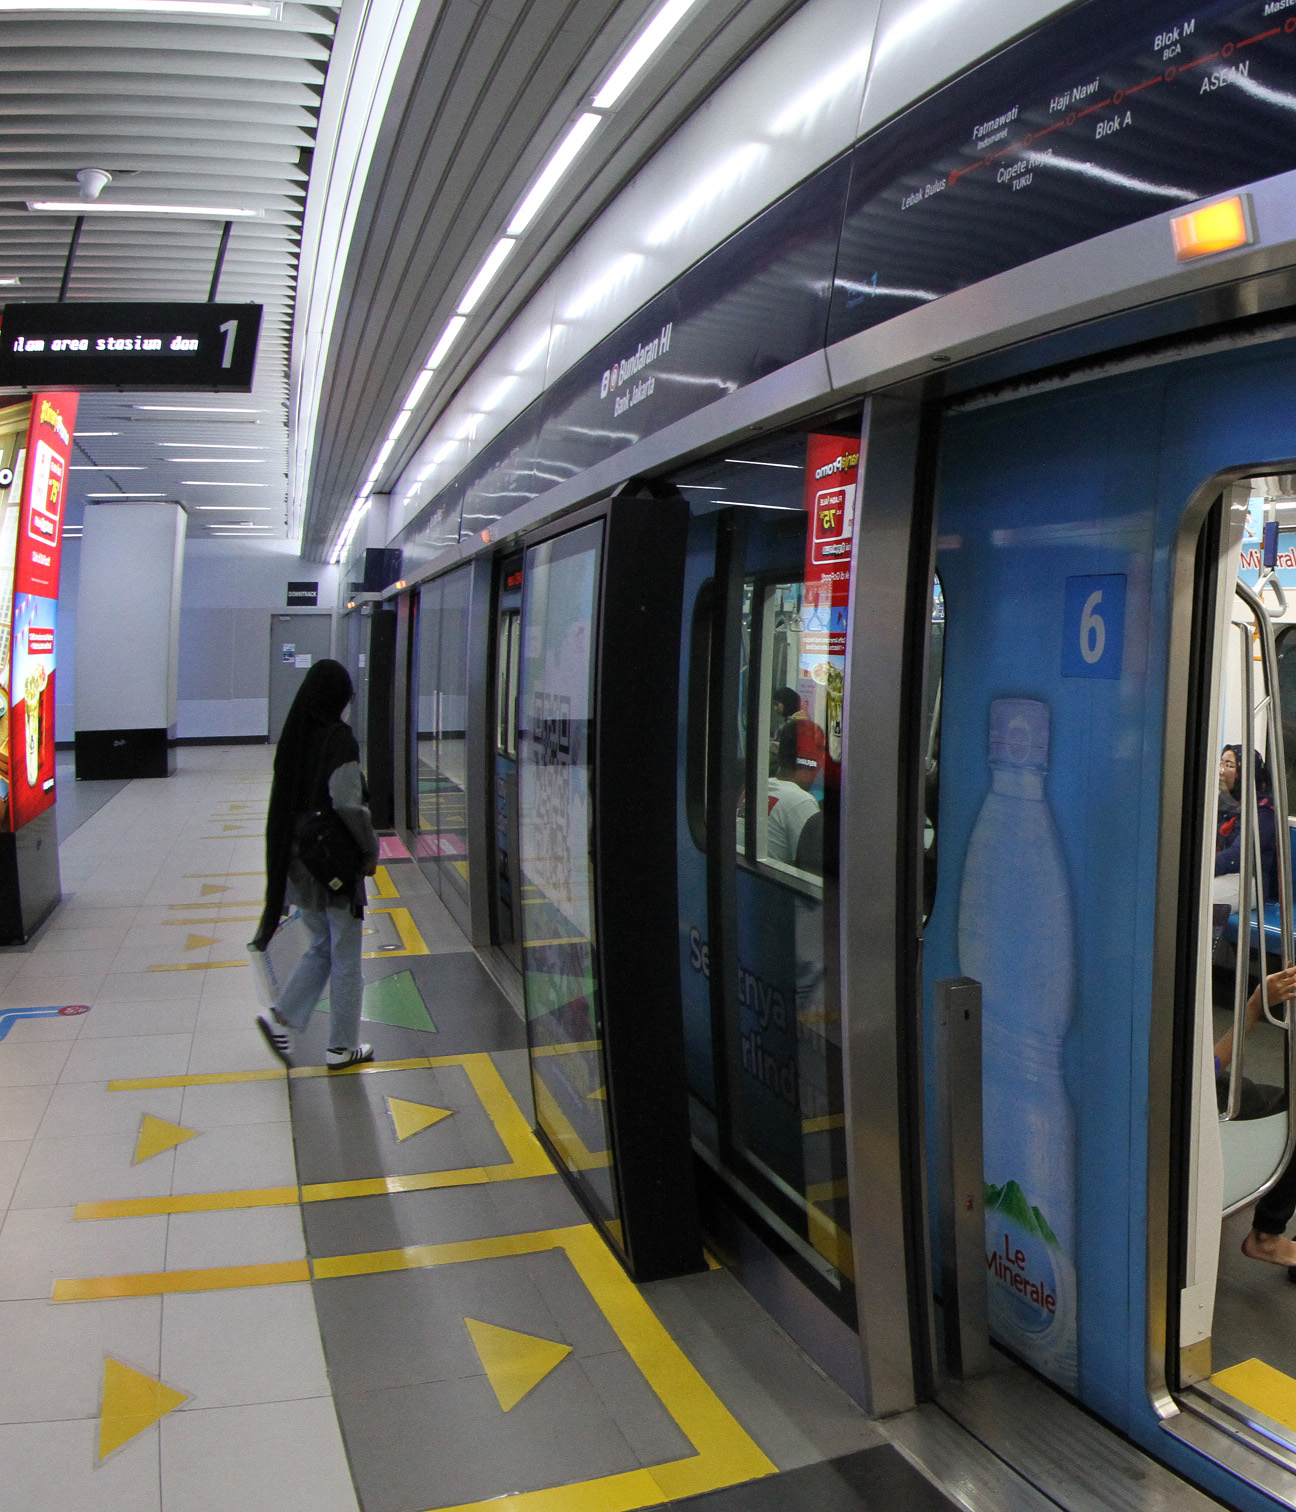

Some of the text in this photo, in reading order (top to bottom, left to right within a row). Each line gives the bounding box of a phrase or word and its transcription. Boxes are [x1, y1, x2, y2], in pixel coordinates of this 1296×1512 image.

[1154, 19, 1195, 51] Blok M
[1163, 44, 1181, 61] BCA
[1200, 60, 1249, 94] ASEAN
[1049, 77, 1099, 114] Haji Nawi
[972, 104, 1019, 140] Fatmawati
[1095, 110, 1132, 140] Blok A
[997, 161, 1027, 184] Cipete
[1012, 173, 1032, 192] TUKU
[901, 178, 946, 210] Lebak Bulus
[51, 339, 89, 351] area
[96, 336, 162, 351] stasiun
[170, 336, 199, 351] dan
[219, 319, 239, 369] 1
[618, 338, 659, 387] Bundaran
[659, 321, 673, 355] HI
[614, 376, 655, 418] Bank Jakarta
[1081, 590, 1105, 663] 6
[1004, 1234, 1026, 1271] Le
[985, 1250, 1057, 1315] Minerale
